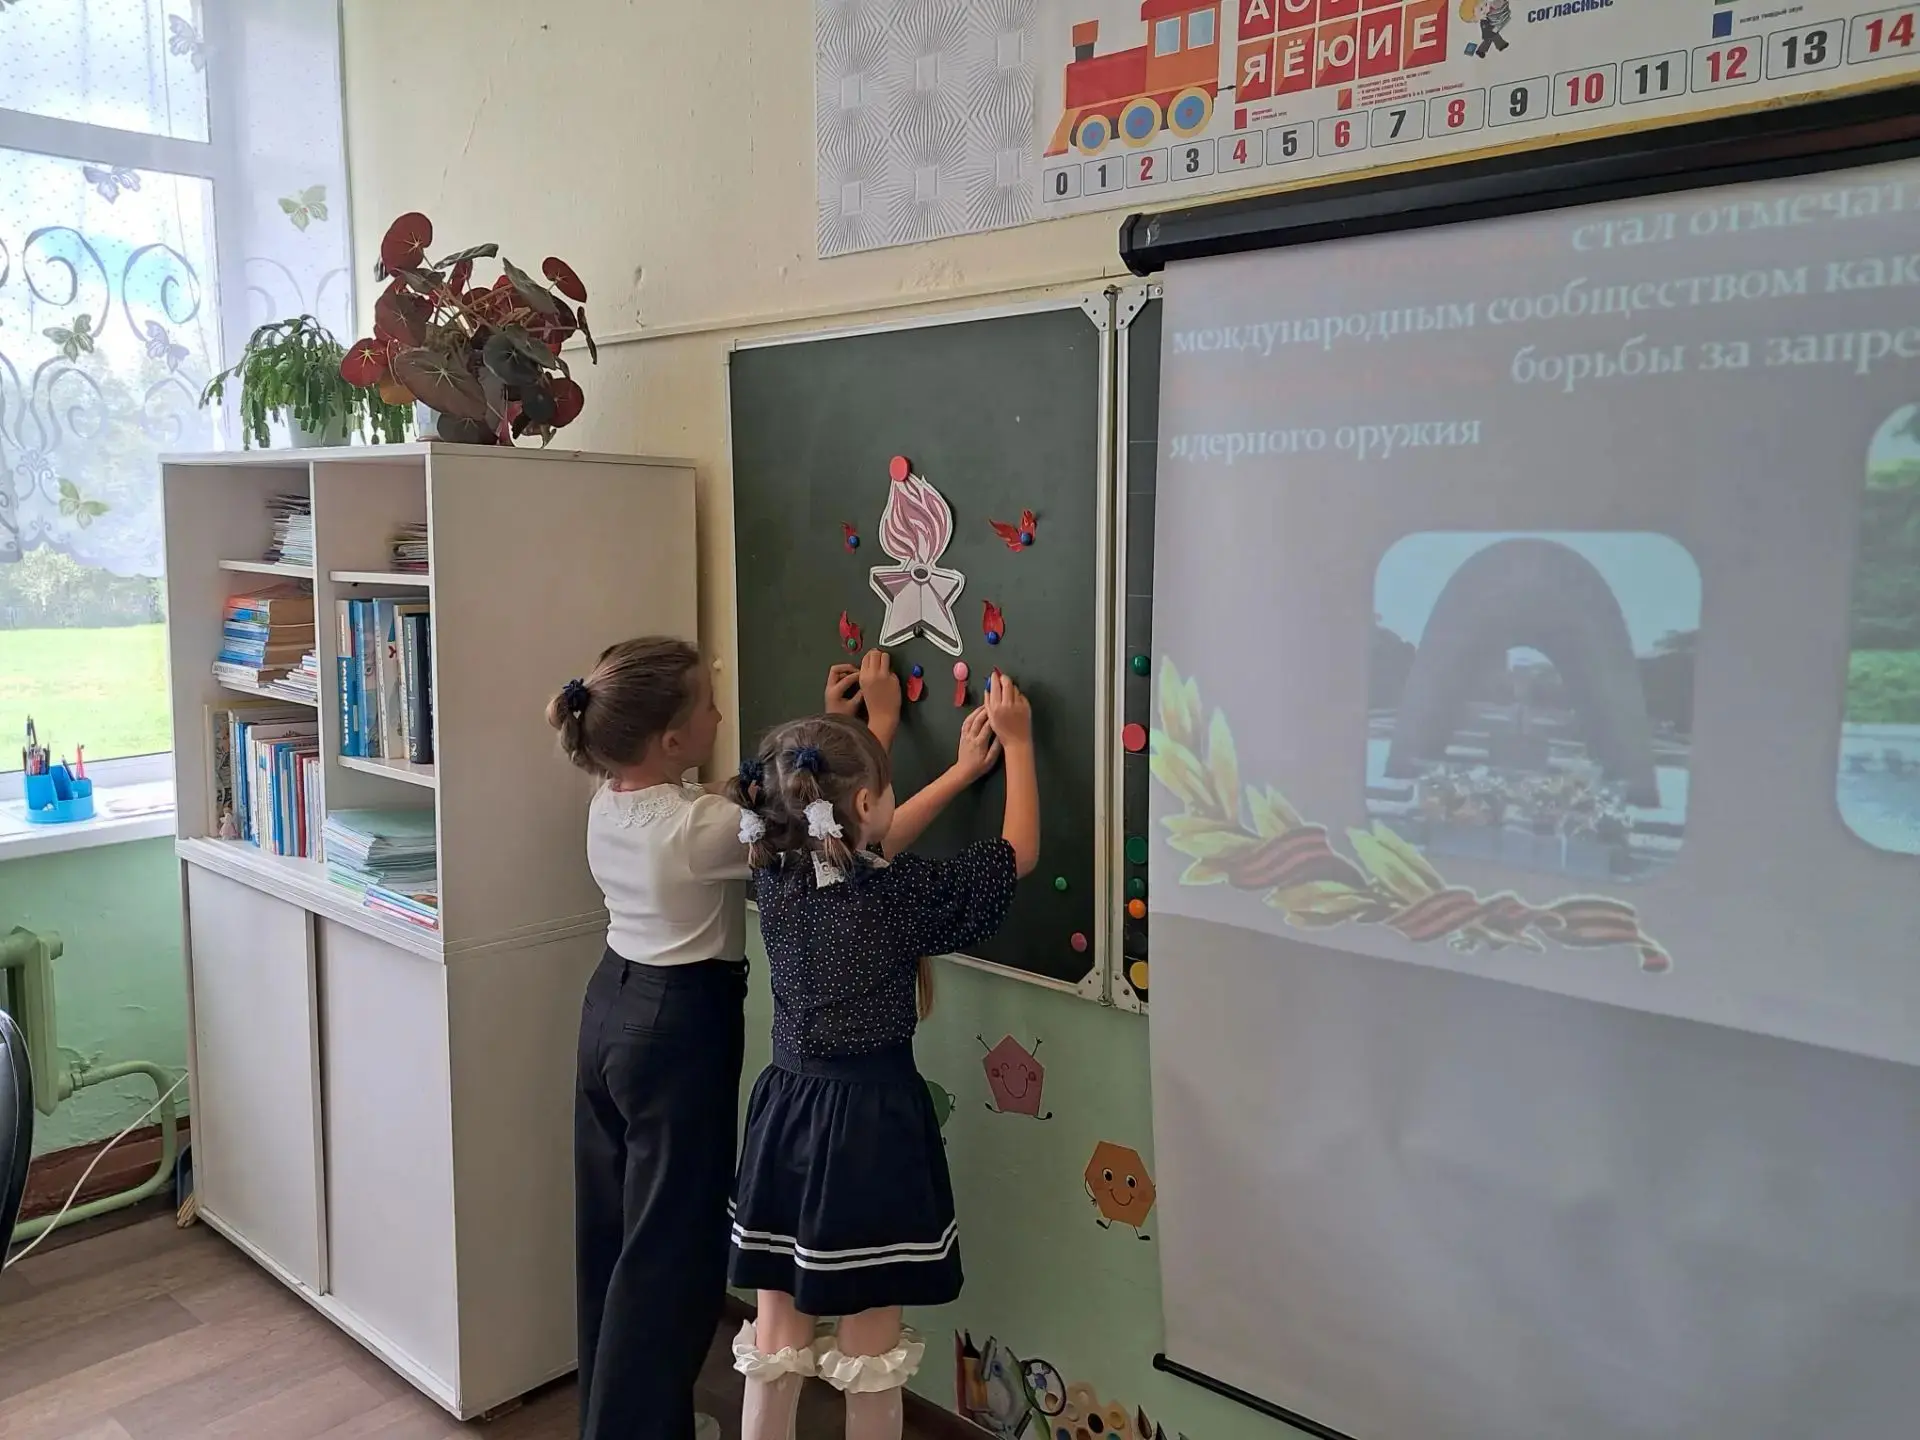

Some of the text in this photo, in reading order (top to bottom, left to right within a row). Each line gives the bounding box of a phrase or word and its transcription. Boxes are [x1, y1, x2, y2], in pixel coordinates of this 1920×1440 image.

[1244, 0, 1270, 24] А
[1242, 13, 1438, 87] Я Ё Ю И Е
[1055, 13, 1915, 196] 0 1 2 3 4 5 6 7 8 9 10 11 12 13 14
[1571, 212, 1676, 252] стал
[1172, 253, 1920, 356] международным сообществом как
[1511, 332, 1687, 394] борьбы
[1699, 340, 1750, 371] за
[1765, 323, 1920, 375] запре
[1169, 420, 1481, 466] ядерного оружия
